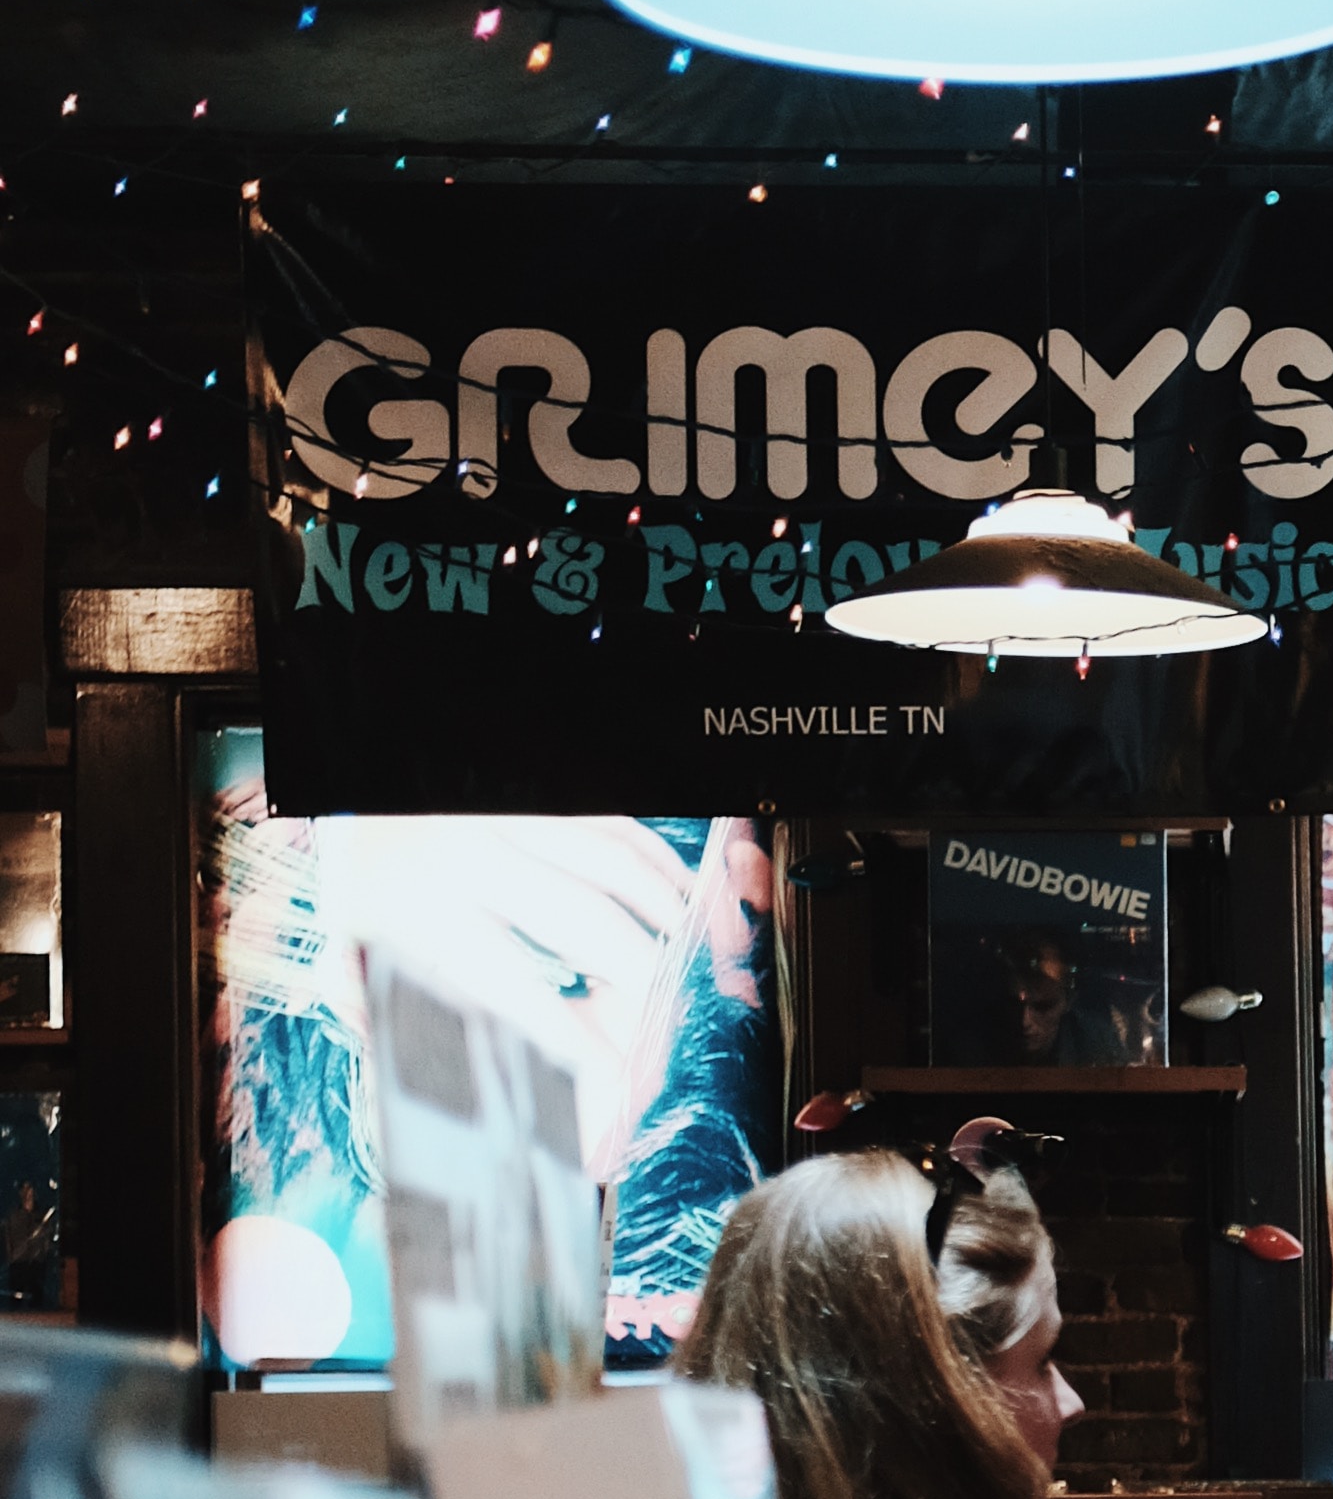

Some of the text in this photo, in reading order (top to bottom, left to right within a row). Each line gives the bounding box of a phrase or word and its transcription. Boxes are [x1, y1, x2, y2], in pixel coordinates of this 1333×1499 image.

[295, 522, 498, 616] New
[531, 526, 604, 617] &
[703, 705, 946, 736] NASHVILLE TN
[943, 839, 1152, 920] DAVIDBOWIE
